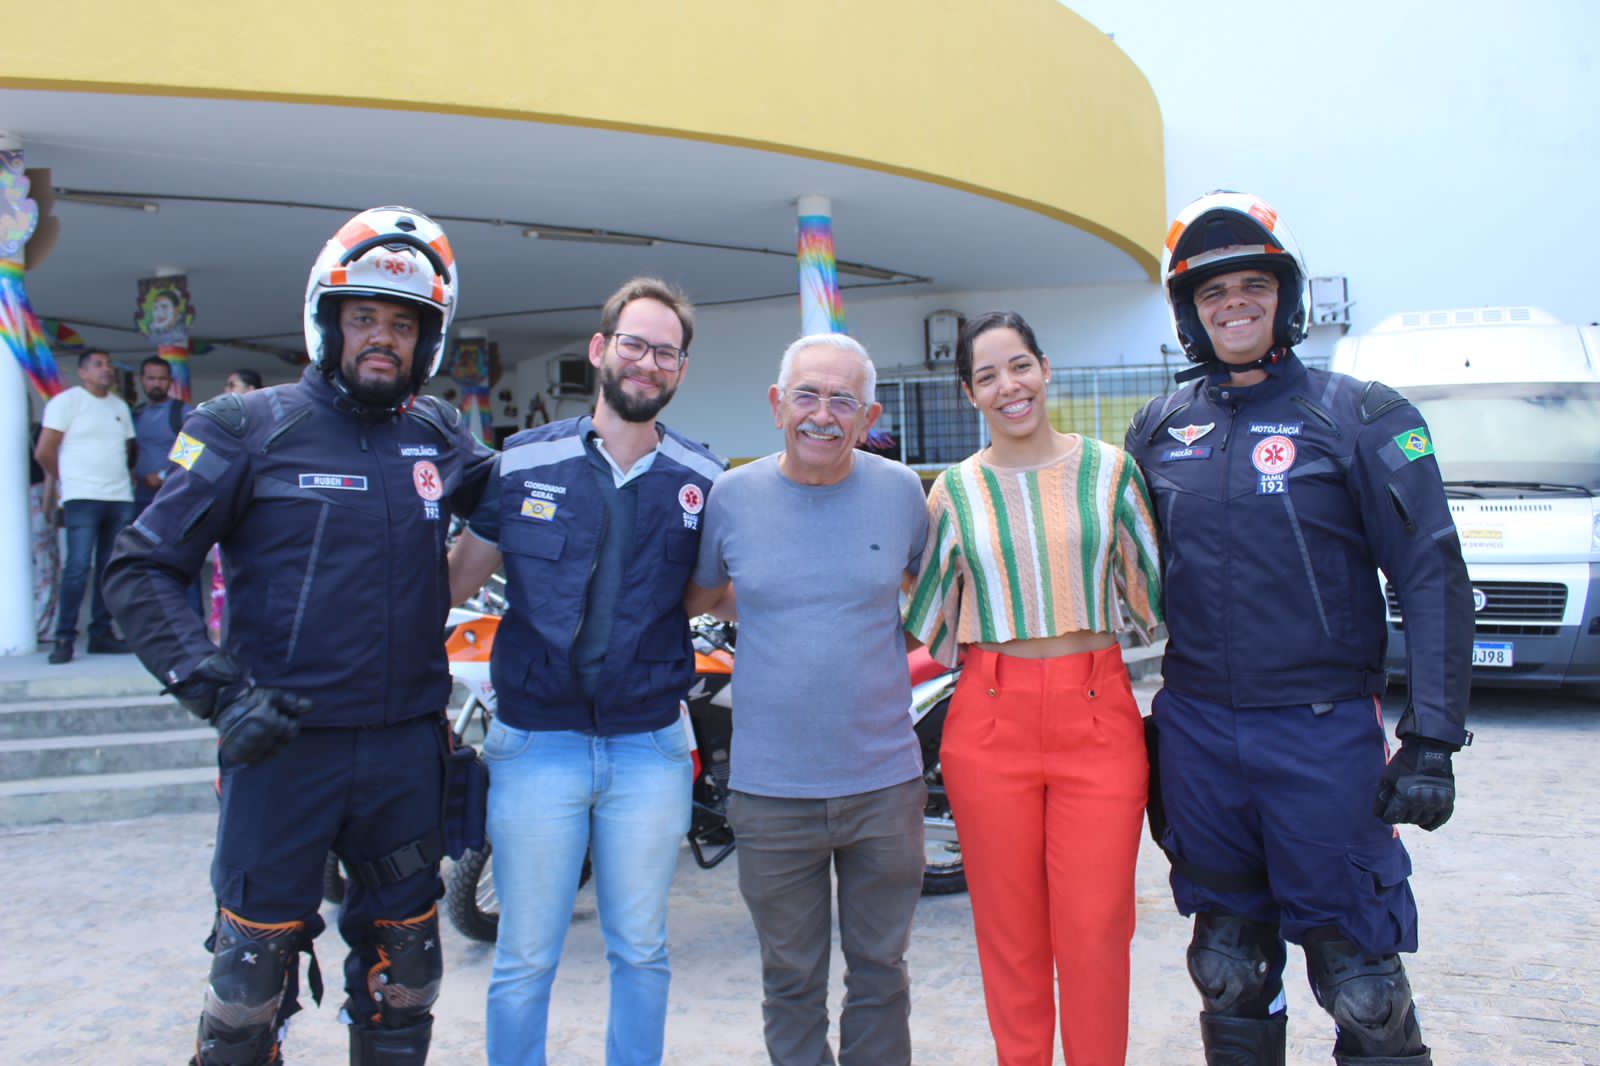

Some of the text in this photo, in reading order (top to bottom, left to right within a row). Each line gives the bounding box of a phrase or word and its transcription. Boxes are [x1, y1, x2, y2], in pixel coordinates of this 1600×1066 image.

[1250, 423, 1299, 434] MOTOLÂNCIA
[314, 476, 341, 486] RUBEN
[1261, 481, 1284, 493] 192
[424, 507, 439, 518] 192
[684, 519, 697, 530] 192
